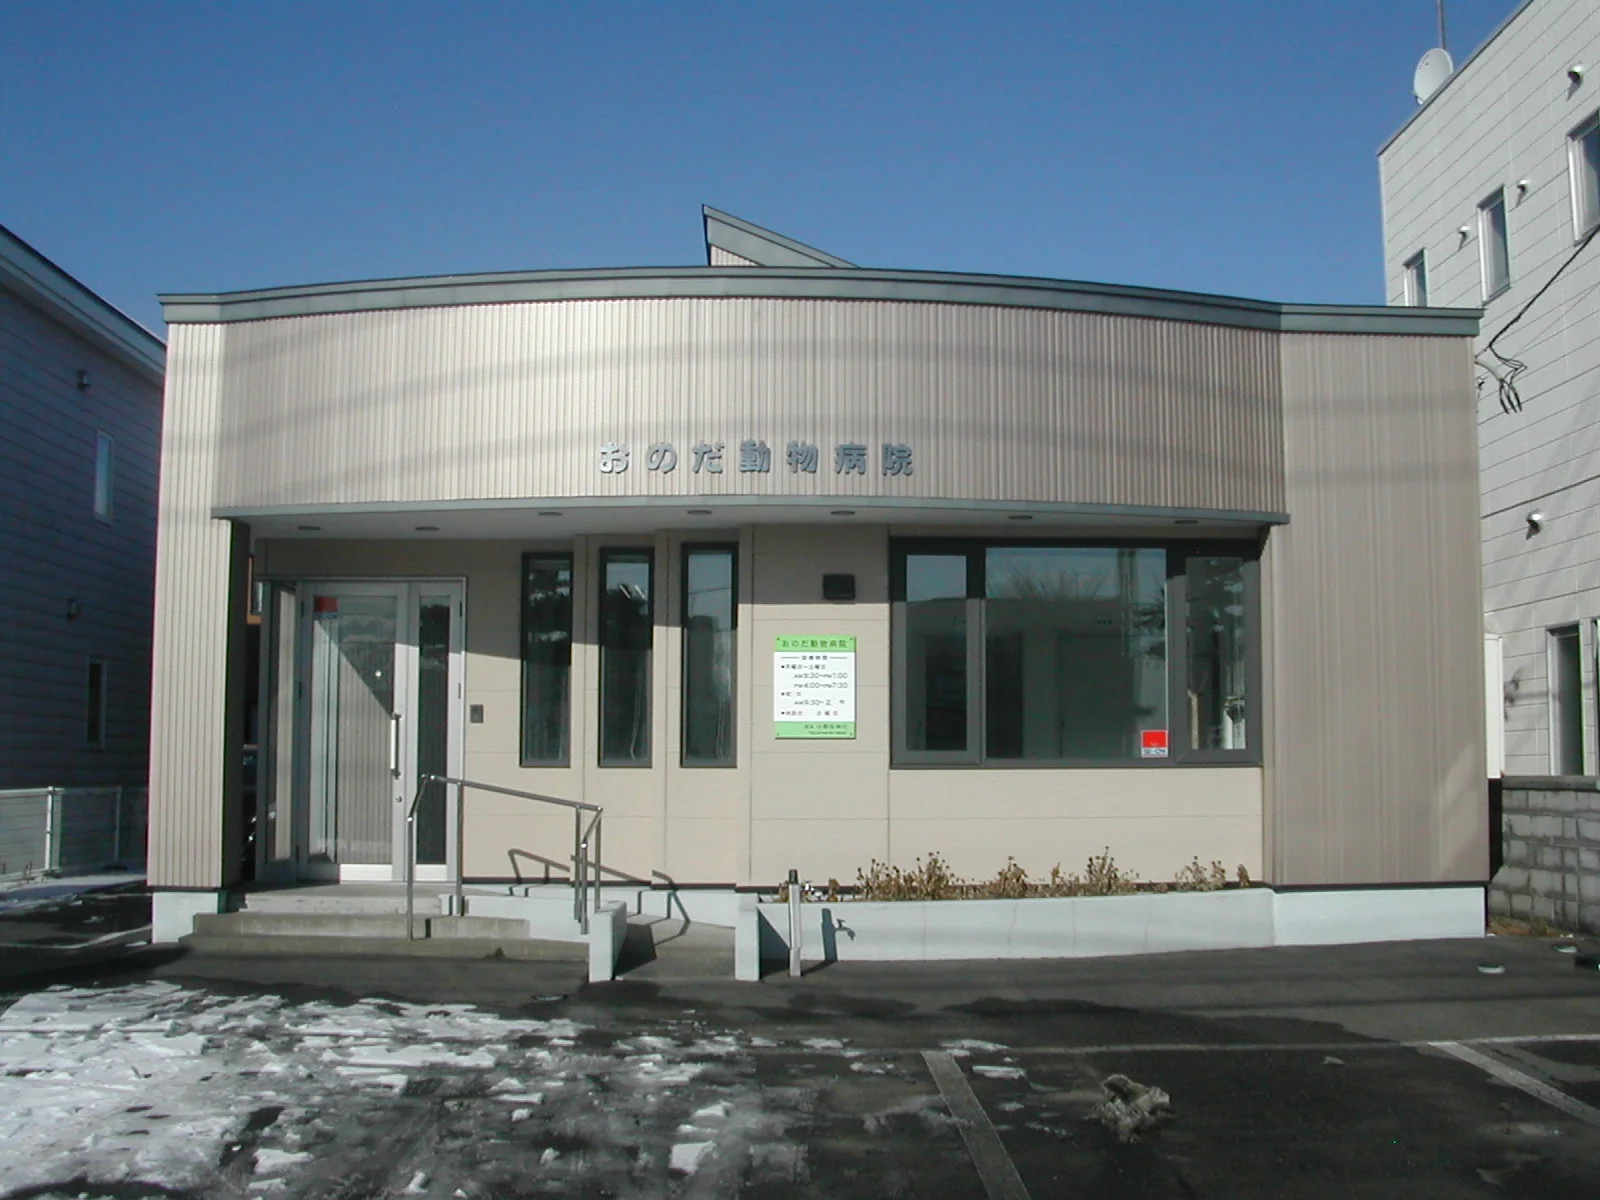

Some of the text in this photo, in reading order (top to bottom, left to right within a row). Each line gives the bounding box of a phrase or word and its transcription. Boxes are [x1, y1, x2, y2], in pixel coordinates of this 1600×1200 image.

[599, 440, 914, 476] おのだ動物病院
[782, 639, 847, 648] おのだ動物病院
